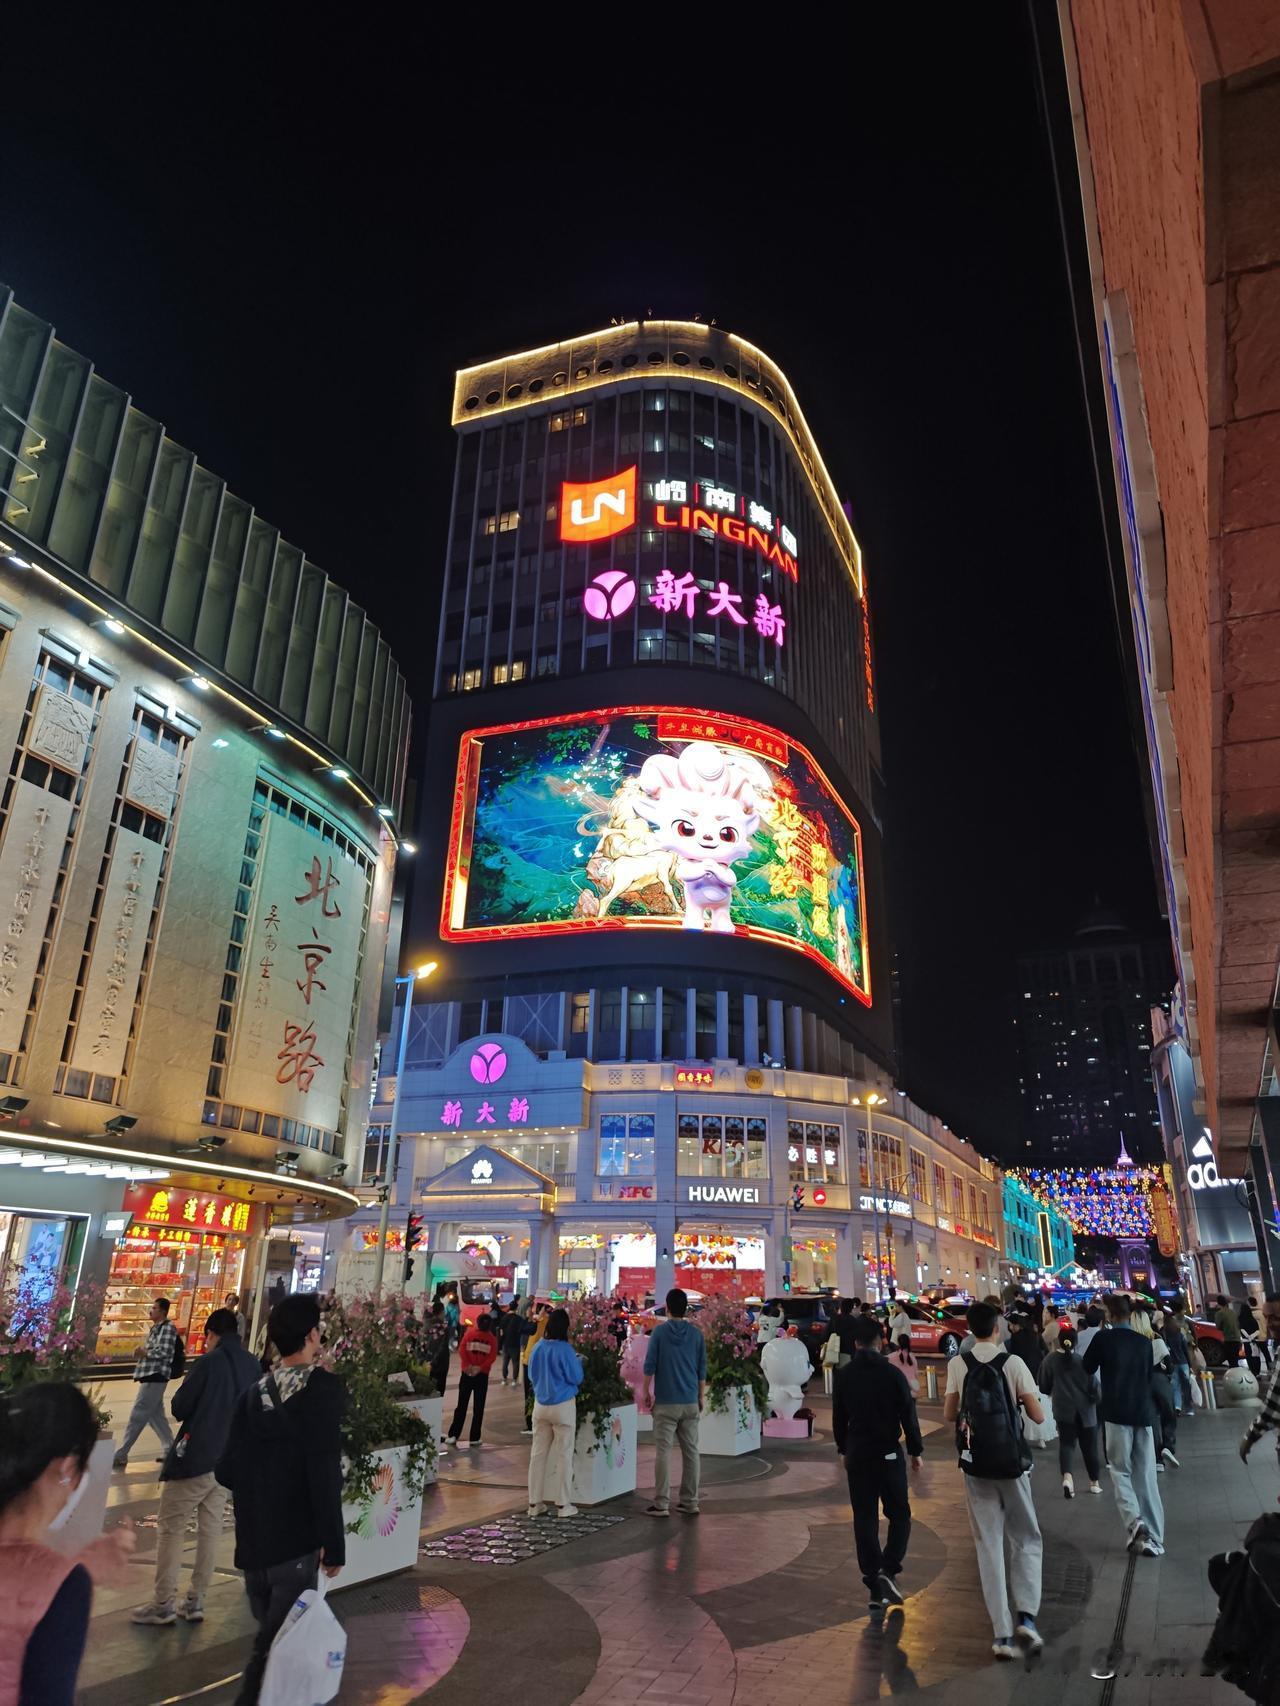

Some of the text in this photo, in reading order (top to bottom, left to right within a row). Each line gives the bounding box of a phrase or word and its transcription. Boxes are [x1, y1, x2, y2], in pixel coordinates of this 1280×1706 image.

[656, 504, 798, 584] LINGNAN
[648, 568, 787, 647] 新大新
[276, 855, 342, 1093] 北京路
[440, 1097, 530, 1129] 新大新
[688, 1186, 759, 1204] HUAWEI
